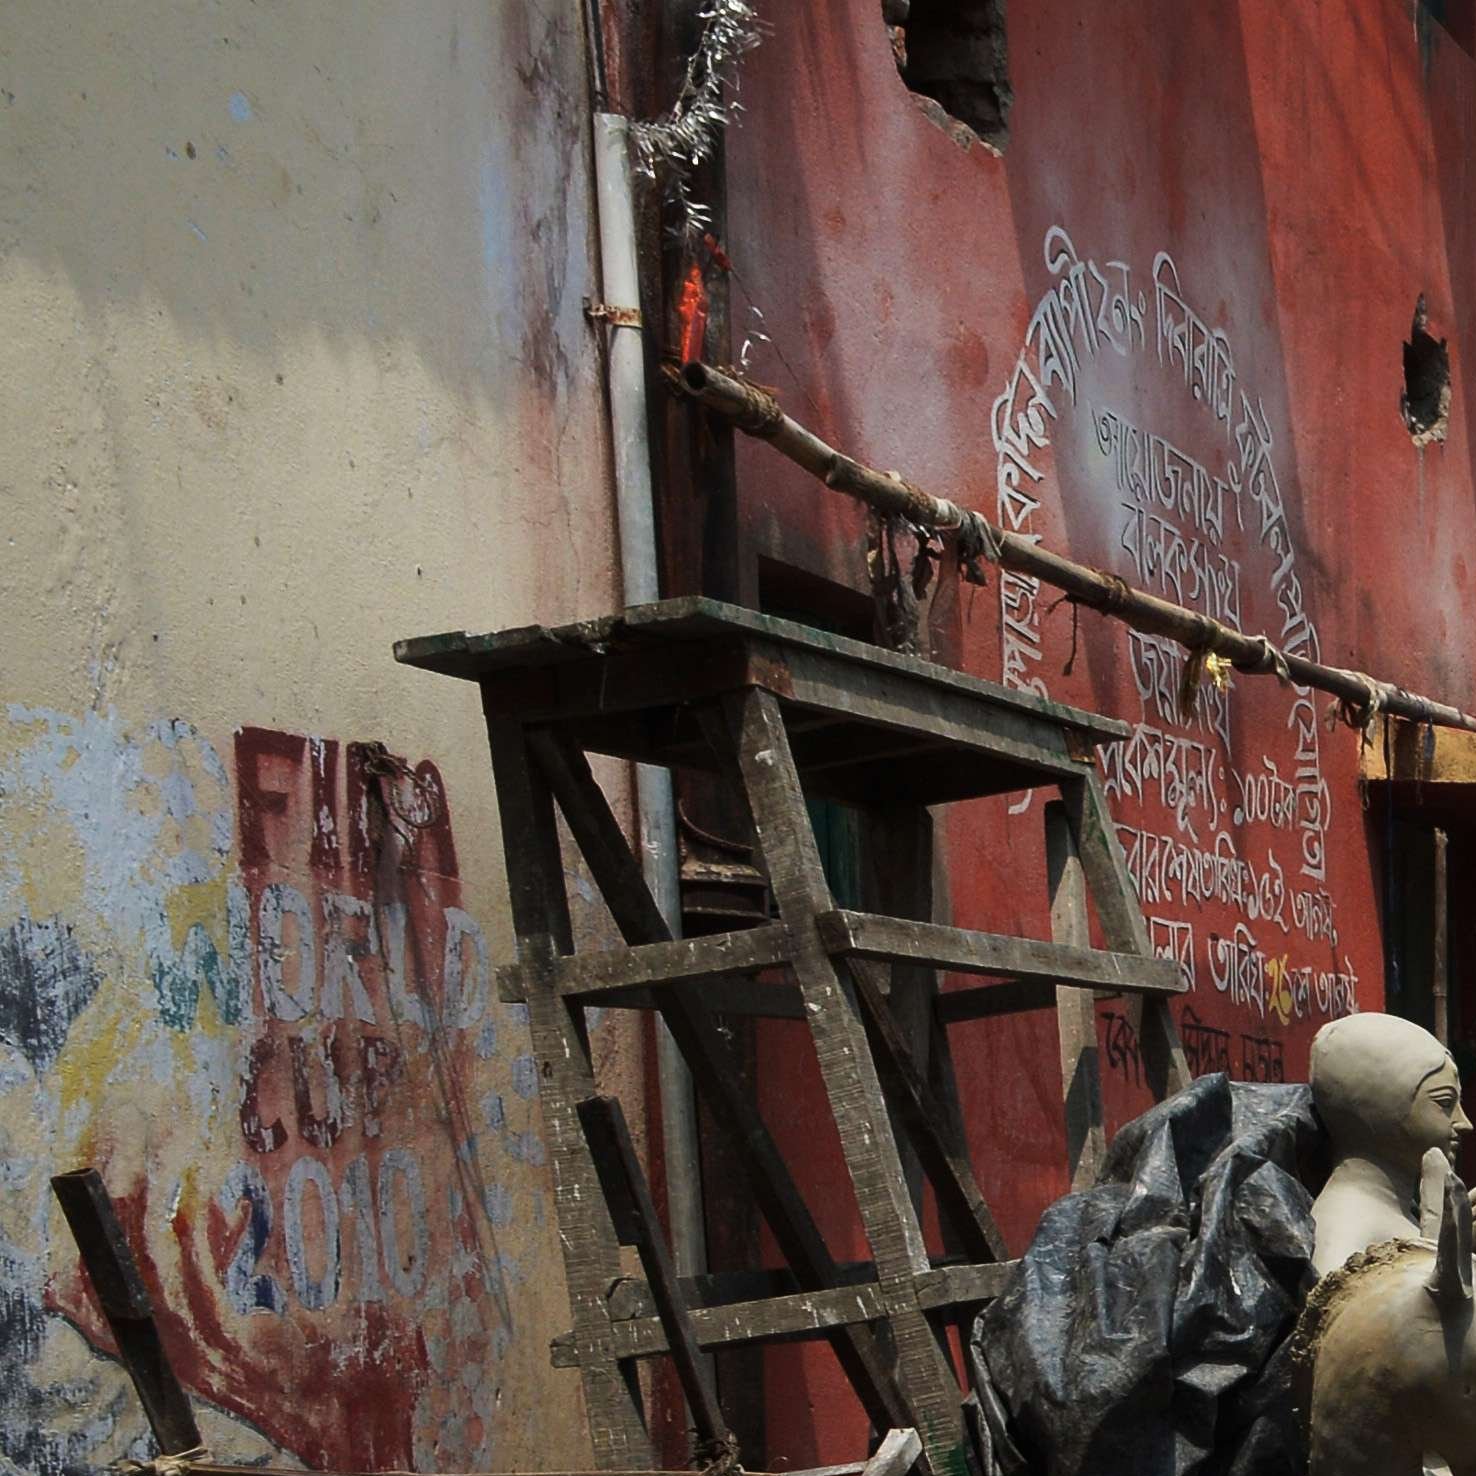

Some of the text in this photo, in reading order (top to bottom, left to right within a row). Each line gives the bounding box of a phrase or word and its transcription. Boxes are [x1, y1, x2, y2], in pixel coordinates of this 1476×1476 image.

[146, 884, 490, 1033] WORLD
[239, 1032, 403, 1154] CUP
[220, 1147, 429, 1316] 2010
